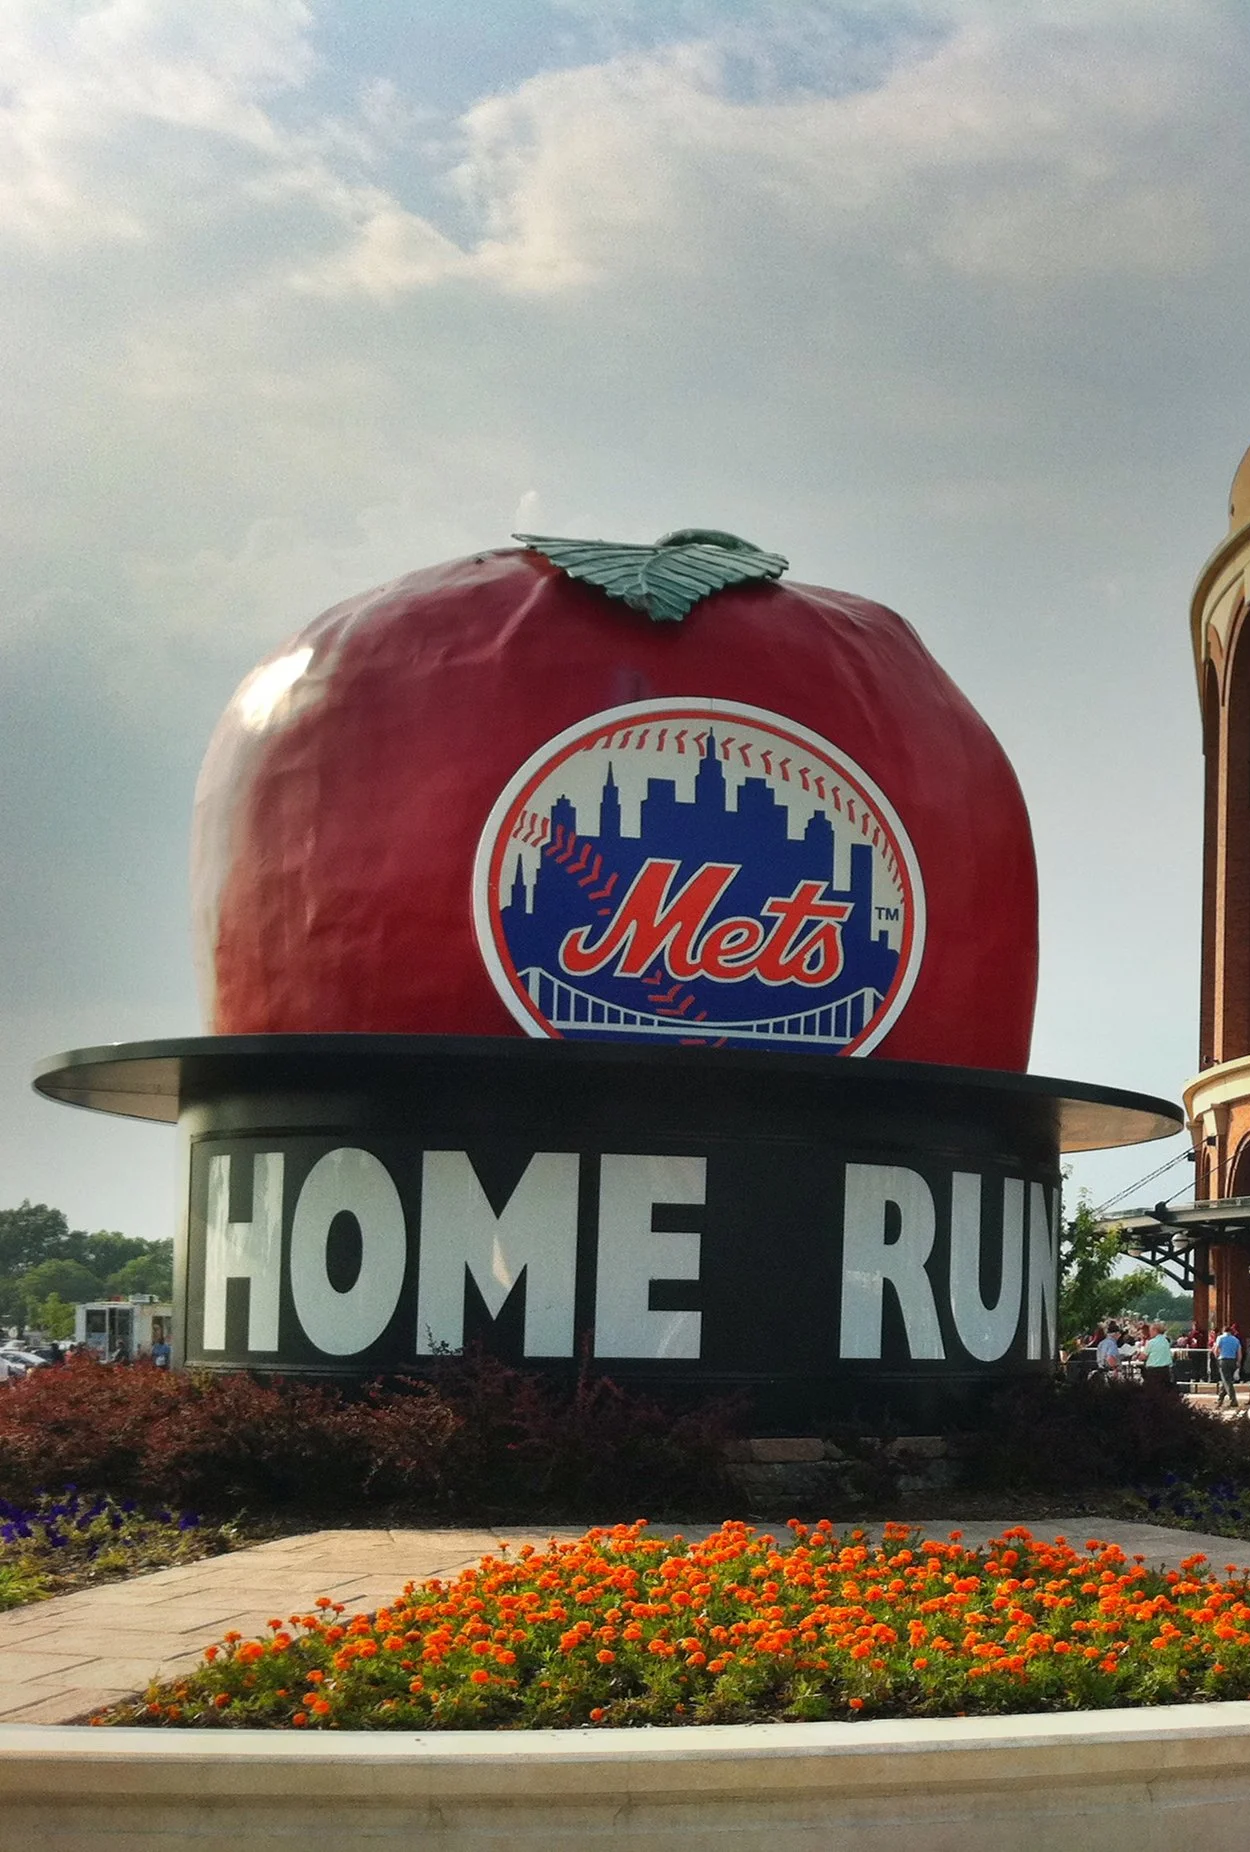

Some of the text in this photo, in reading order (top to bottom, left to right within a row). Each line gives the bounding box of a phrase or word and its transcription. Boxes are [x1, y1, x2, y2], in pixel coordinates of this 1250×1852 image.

[558, 857, 854, 988] Mets
[203, 1147, 1060, 1362] HOME RUN
